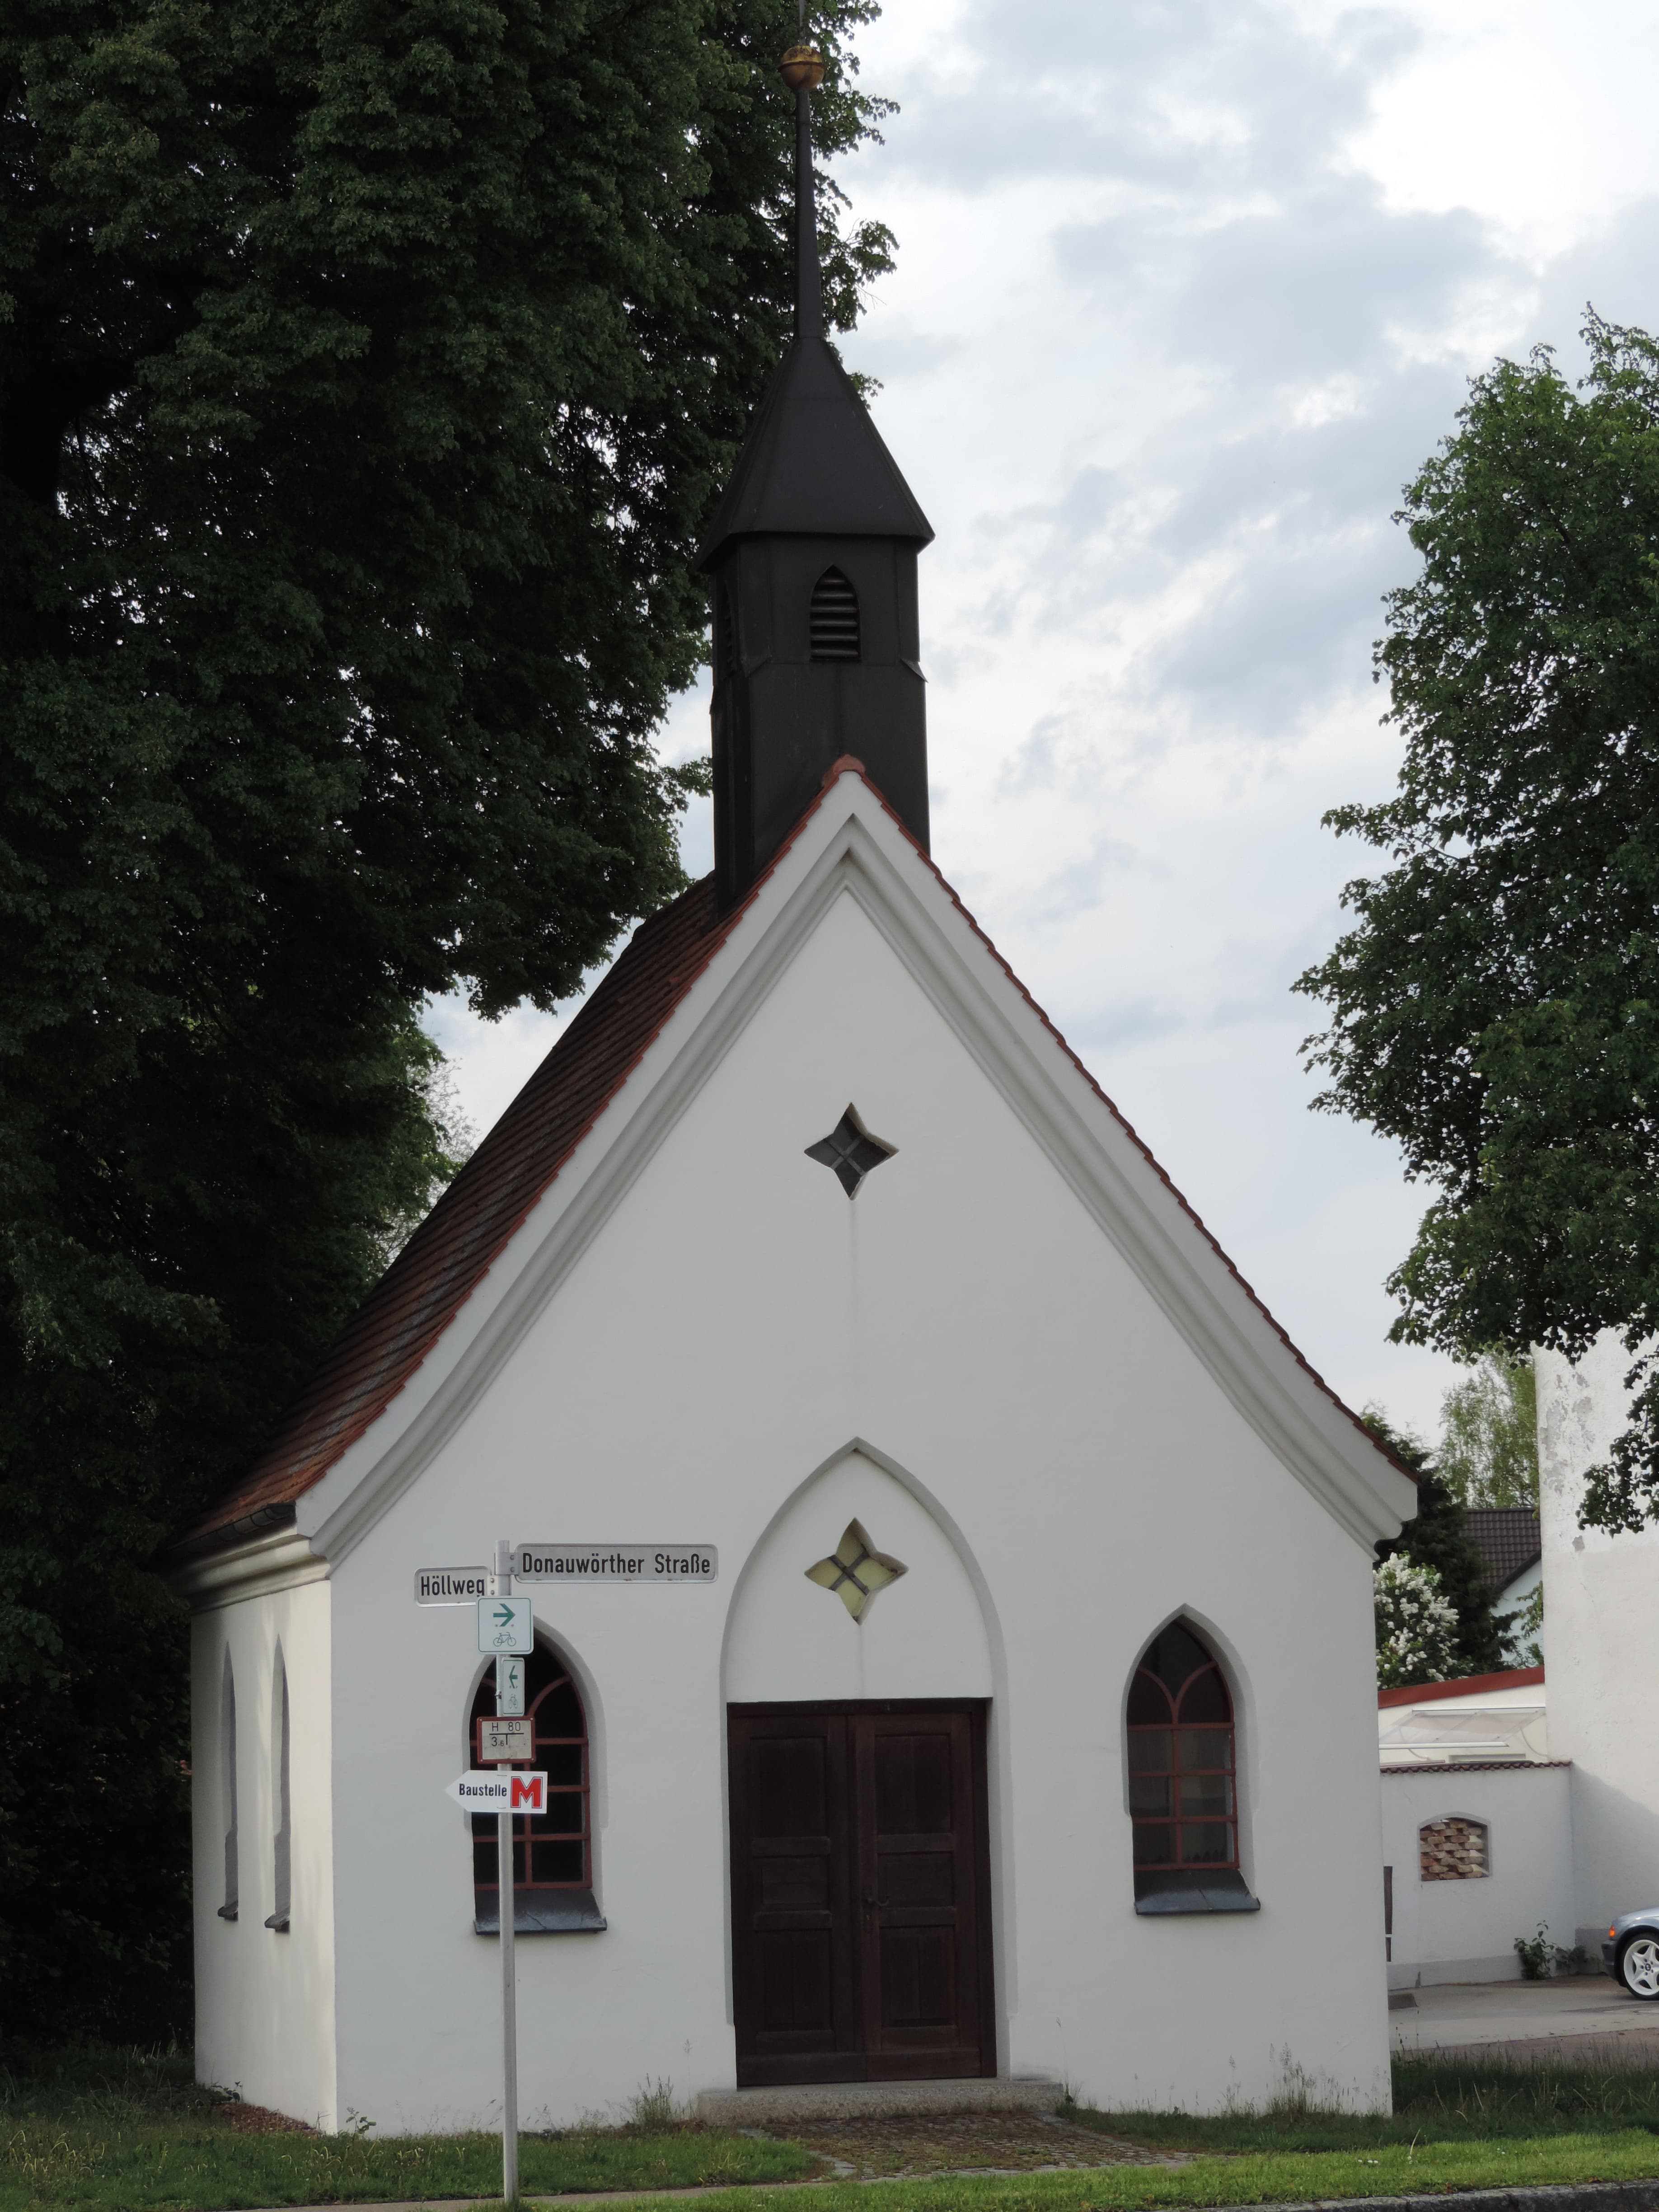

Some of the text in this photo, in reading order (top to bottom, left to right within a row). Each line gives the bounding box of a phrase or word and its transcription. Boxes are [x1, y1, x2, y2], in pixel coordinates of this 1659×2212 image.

[523, 1552, 711, 1574] Donauwörther Straße
[421, 1575, 485, 1597] Höllweg
[492, 1722, 521, 1732] H 80
[459, 1776, 543, 1809] Baustelle M
